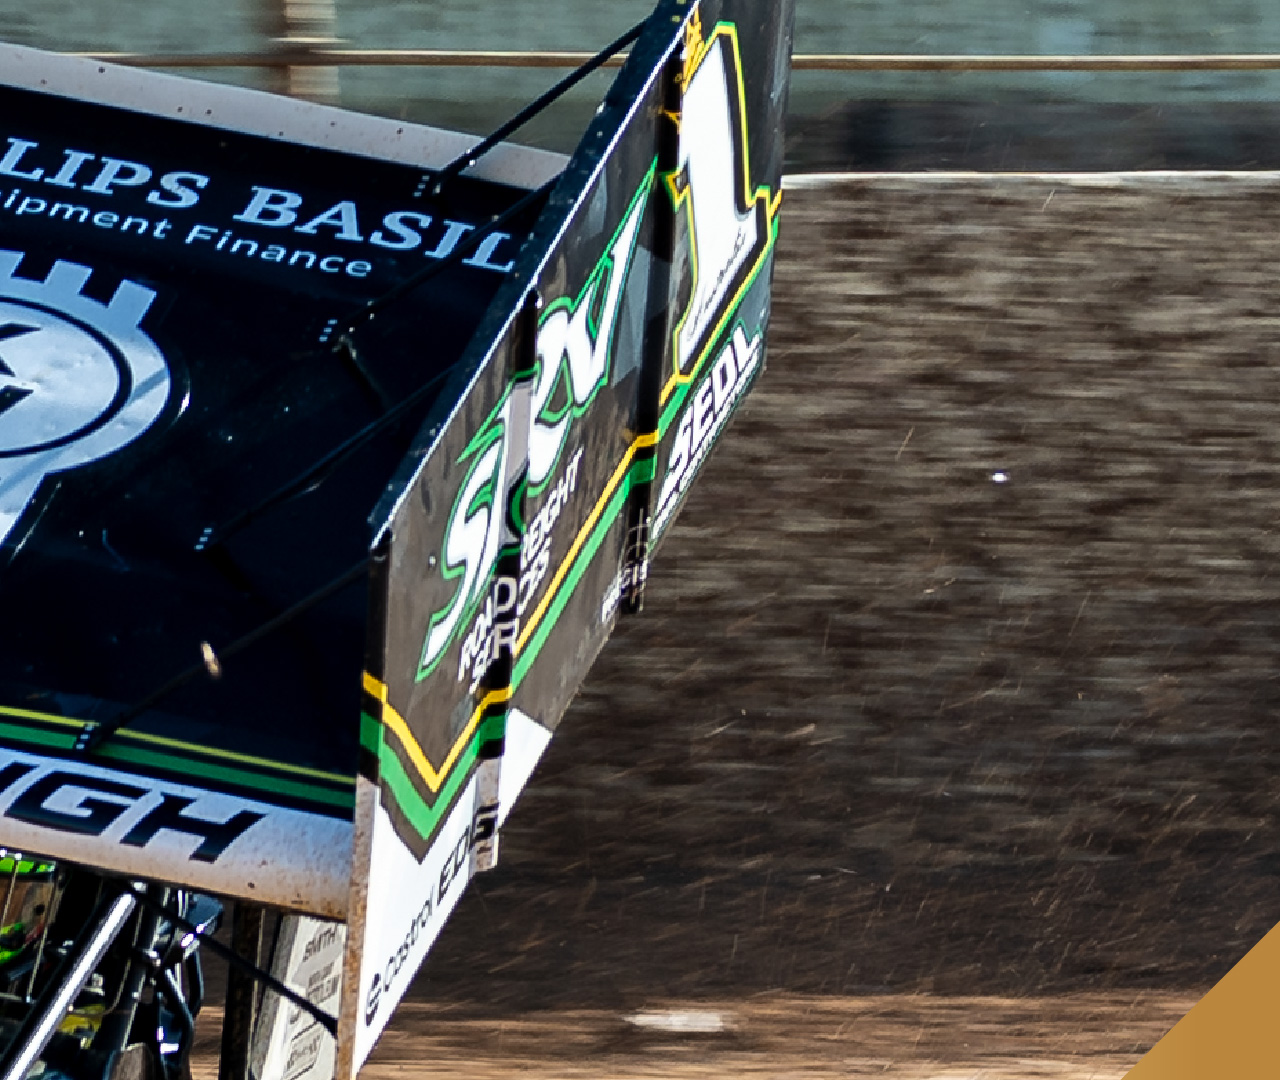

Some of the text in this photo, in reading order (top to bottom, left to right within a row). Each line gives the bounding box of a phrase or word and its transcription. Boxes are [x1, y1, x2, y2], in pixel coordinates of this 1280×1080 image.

[231, 184, 518, 275] BASIL
[668, 22, 775, 382] 1
[183, 222, 374, 278] Finance
